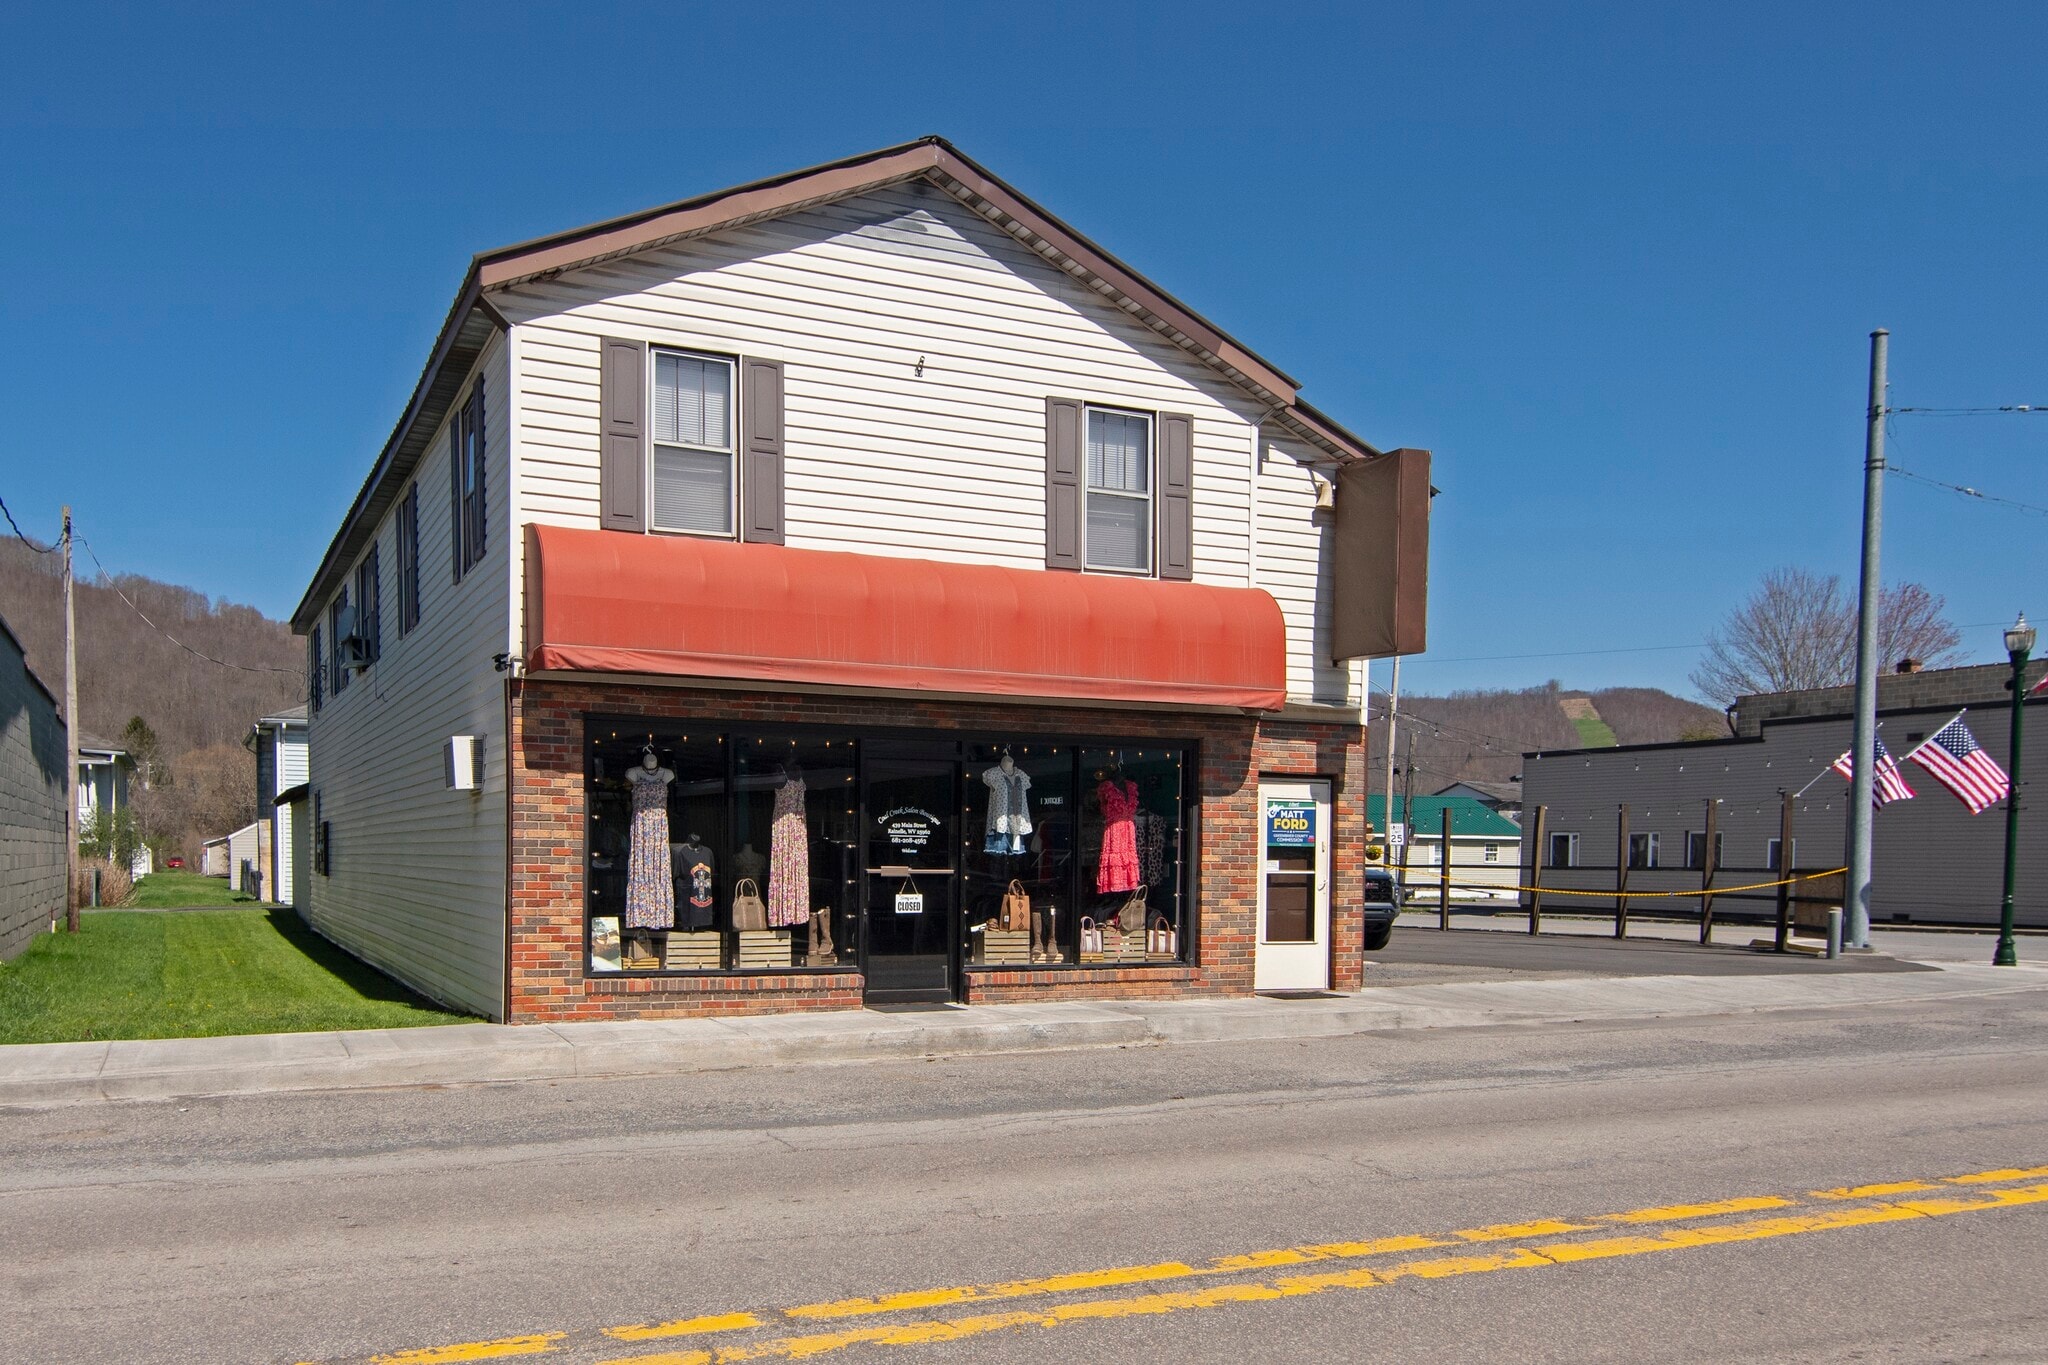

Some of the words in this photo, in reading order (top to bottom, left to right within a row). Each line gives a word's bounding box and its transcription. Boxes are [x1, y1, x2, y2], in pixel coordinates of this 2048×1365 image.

[1274, 818, 1308, 830] FORD
[1391, 834, 1403, 843] 25
[898, 902, 920, 911] CLOSED
